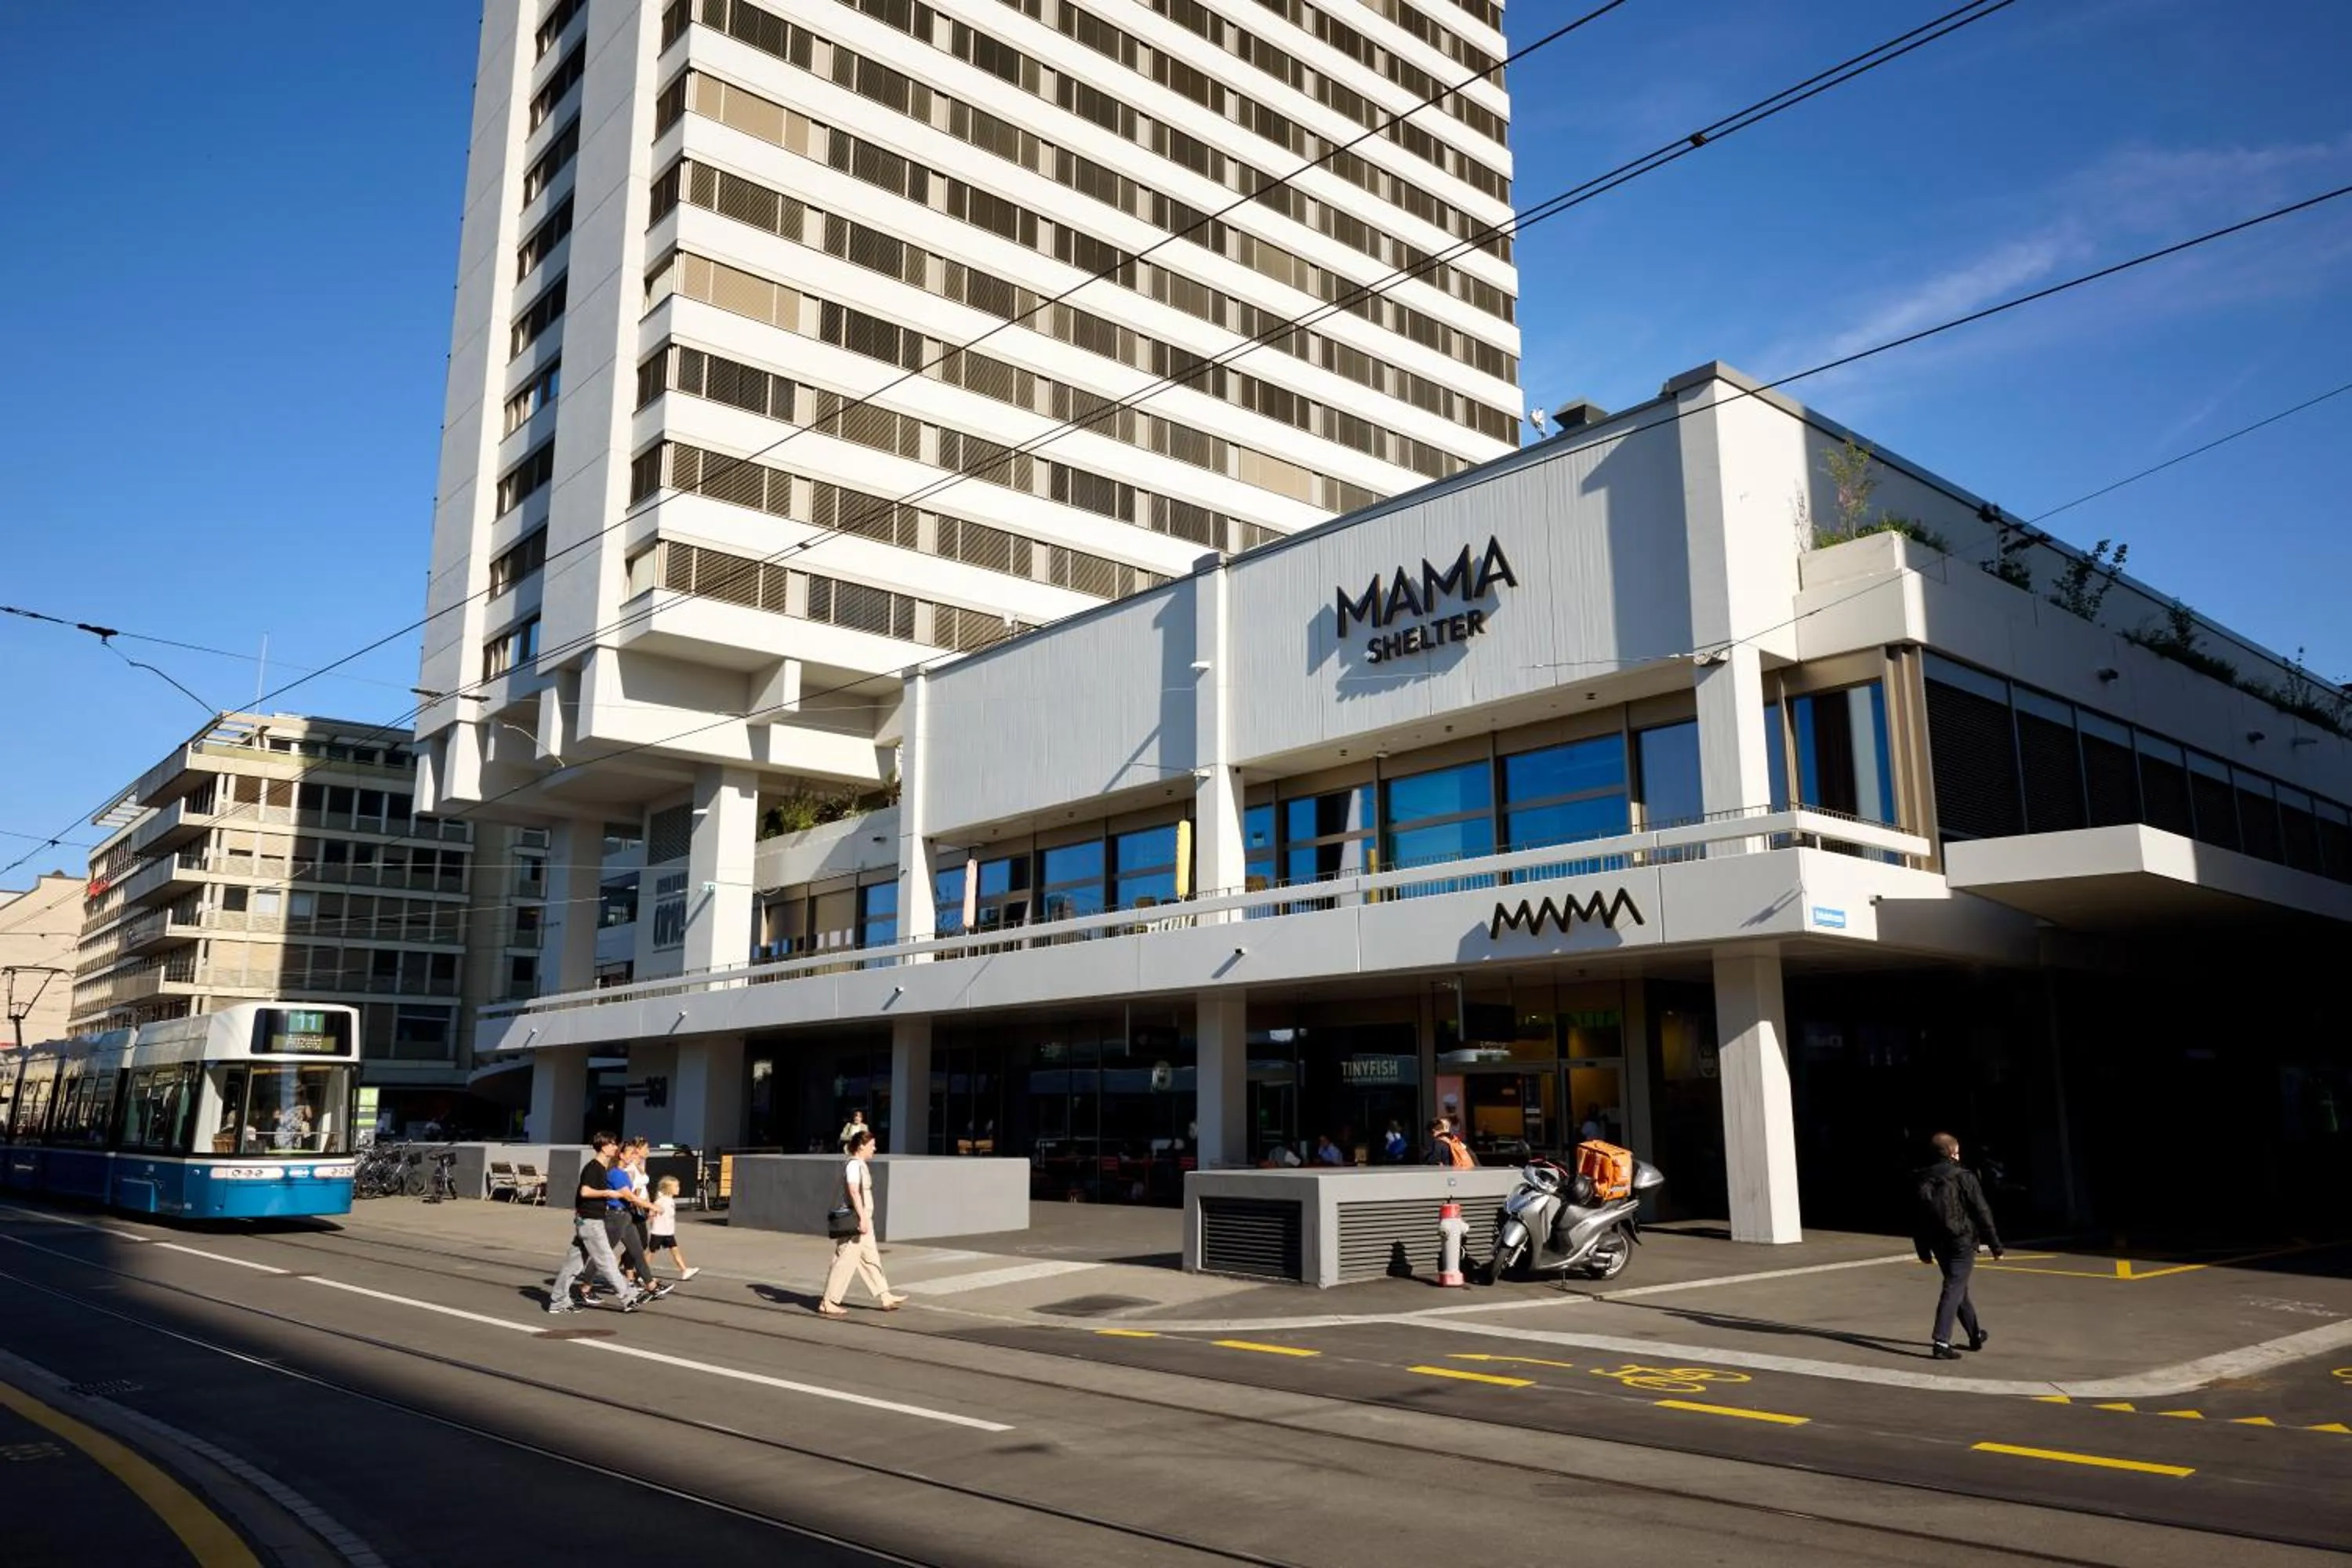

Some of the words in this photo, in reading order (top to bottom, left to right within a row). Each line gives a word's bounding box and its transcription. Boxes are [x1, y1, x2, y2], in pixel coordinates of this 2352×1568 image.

[1336, 535, 1518, 638] MAMA
[1367, 609, 1486, 664] SHELTER
[1490, 887, 1646, 940] MAMA
[297, 1014, 317, 1030] 11
[1340, 1059, 1399, 1076] TINYFISH
